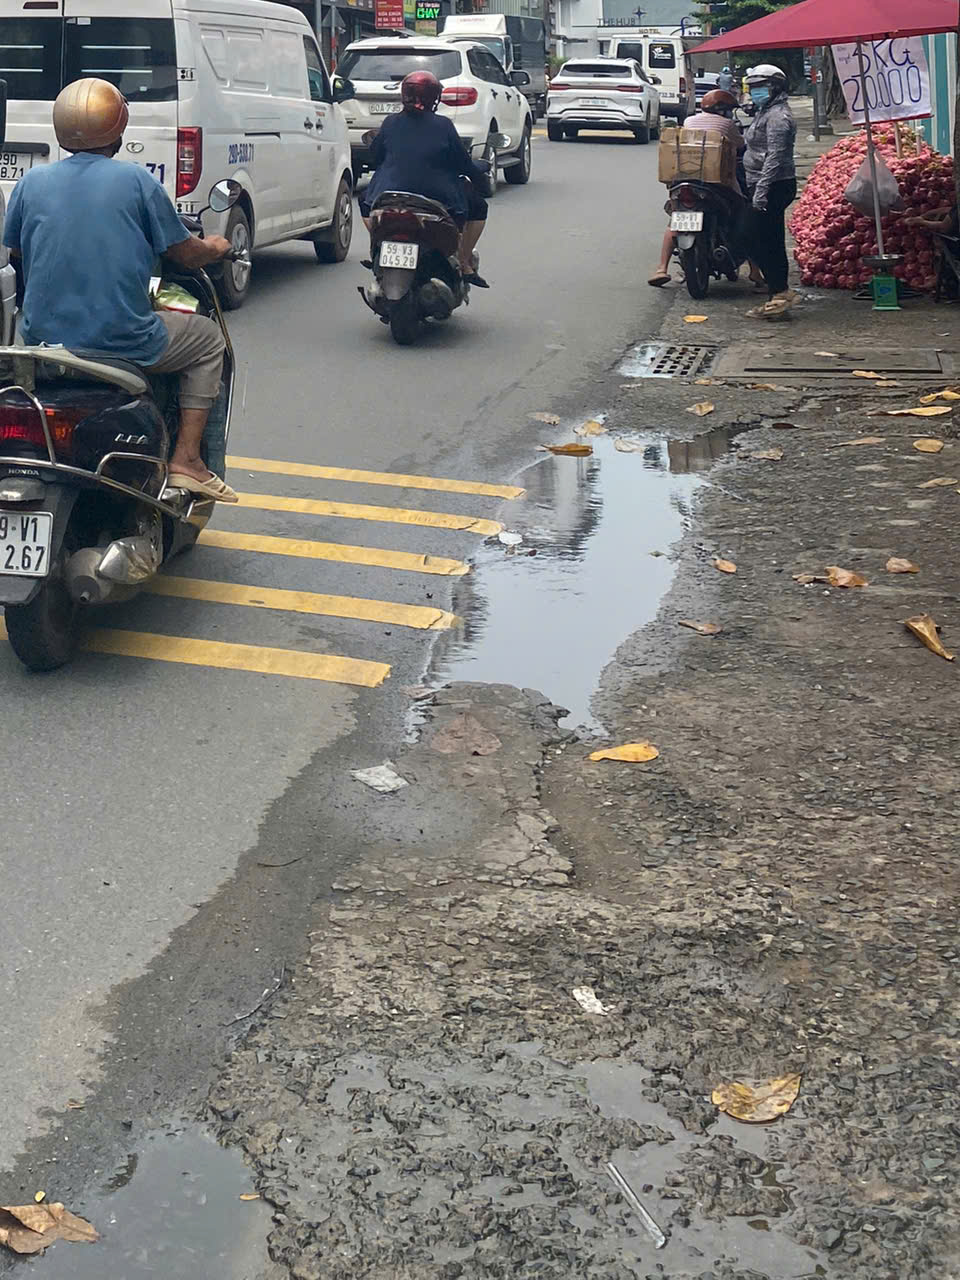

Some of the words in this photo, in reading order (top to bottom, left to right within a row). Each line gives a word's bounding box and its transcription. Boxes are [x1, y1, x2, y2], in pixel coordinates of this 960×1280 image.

[417, 8, 439, 18] CHAY
[145, 163, 165, 185] 71
[8, 468, 40, 476] HONDA
